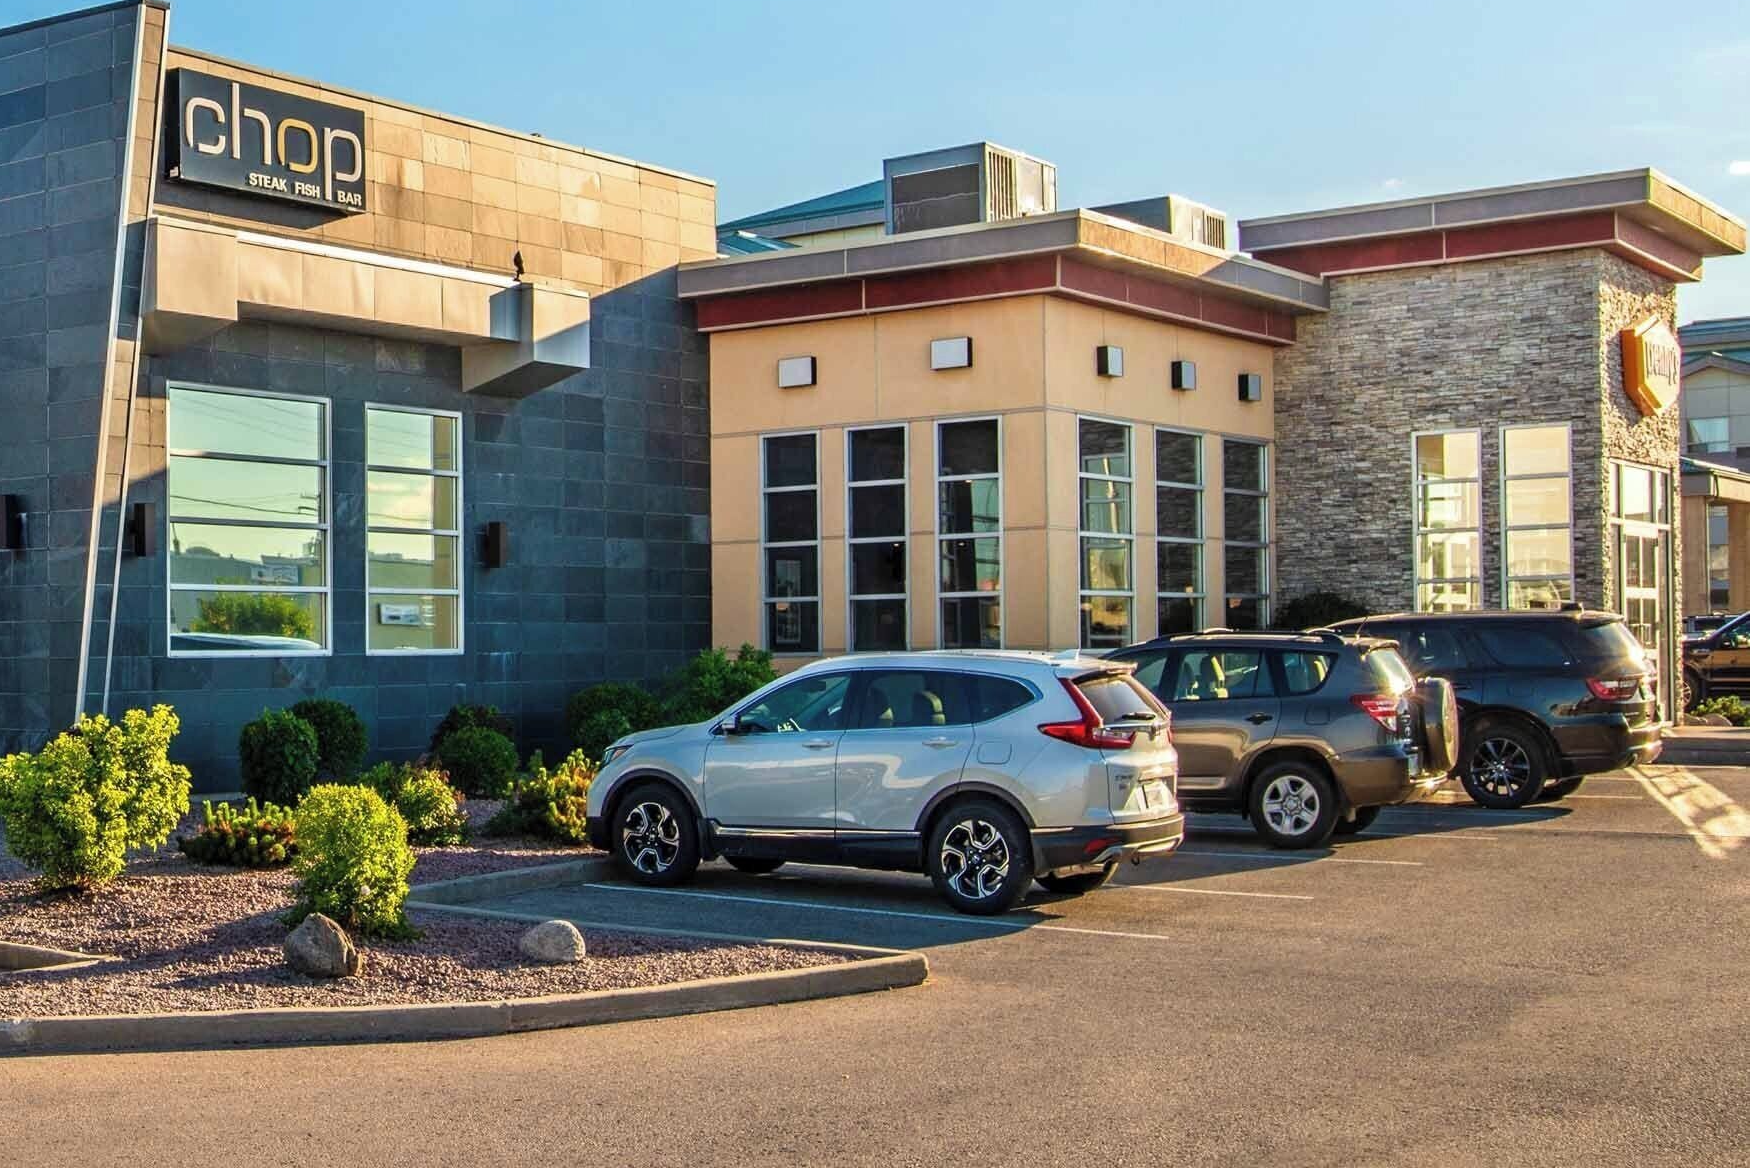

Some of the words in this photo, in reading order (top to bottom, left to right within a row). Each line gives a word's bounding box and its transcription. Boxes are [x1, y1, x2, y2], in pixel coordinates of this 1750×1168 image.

[185, 82, 363, 201] chop
[249, 173, 288, 193] STEAK
[295, 182, 321, 198] FISH
[337, 190, 362, 206] BAR
